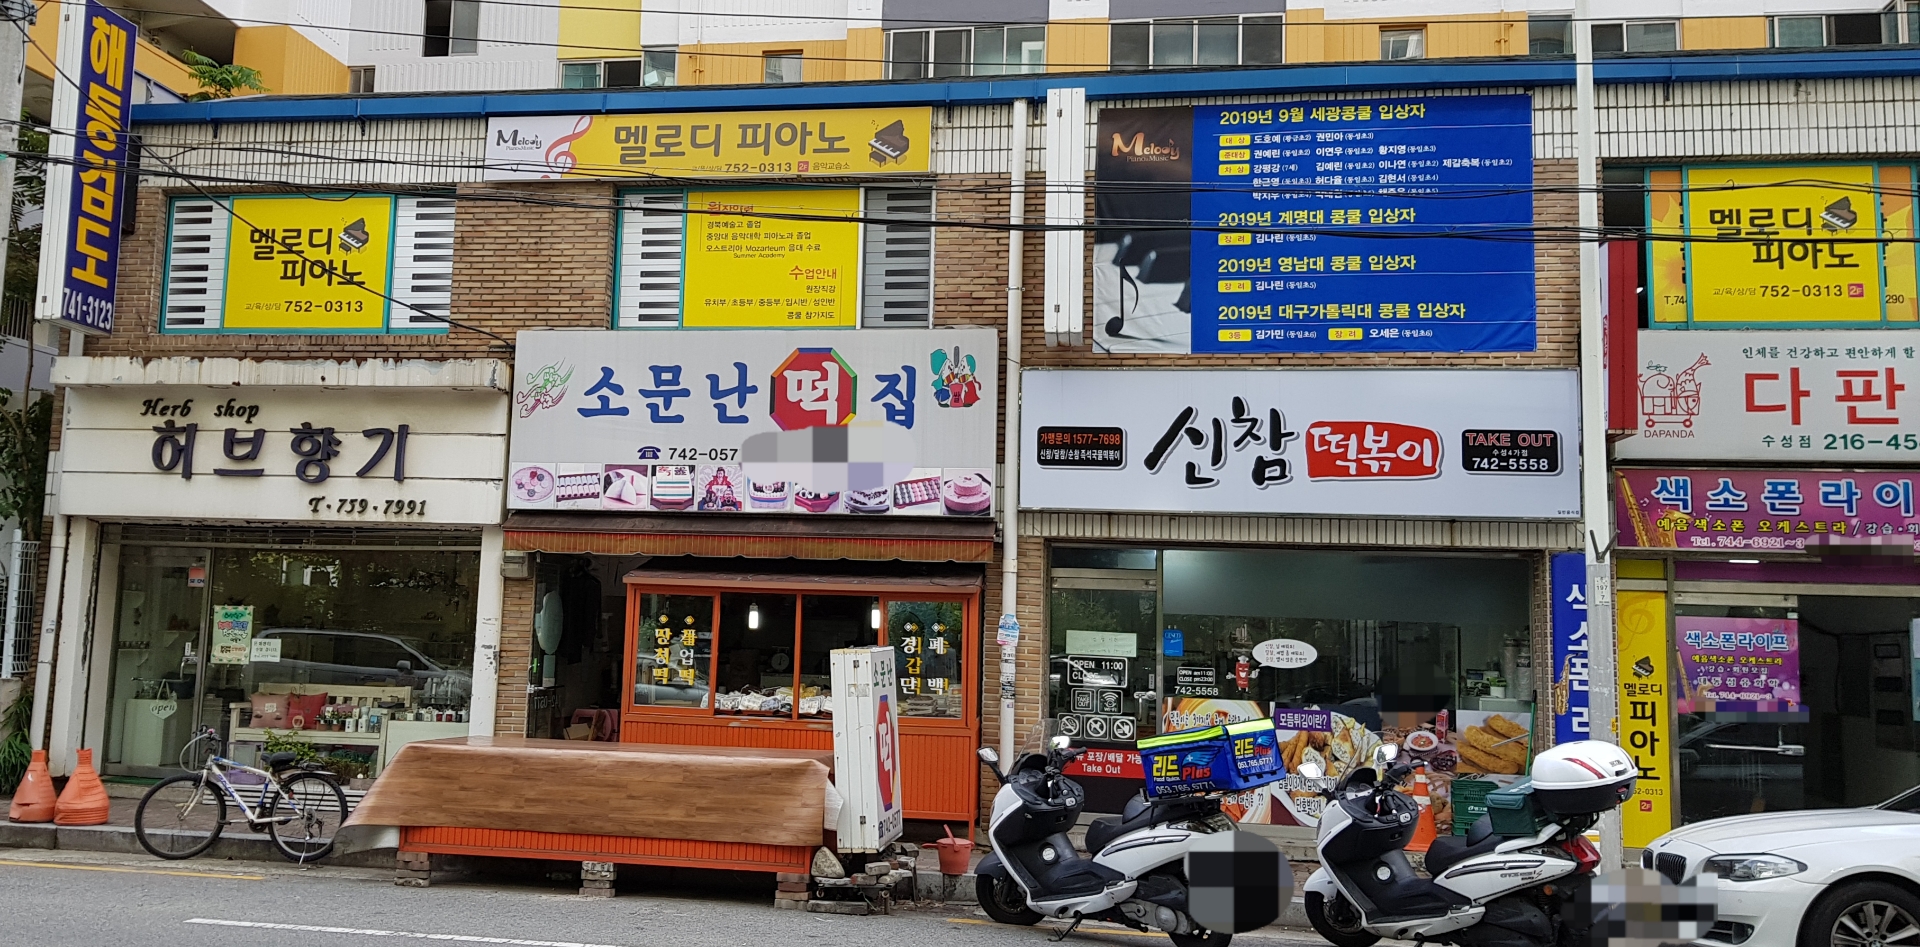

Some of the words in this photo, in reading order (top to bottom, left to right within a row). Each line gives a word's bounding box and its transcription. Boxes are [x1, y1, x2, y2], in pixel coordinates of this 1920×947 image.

[1220, 110, 1272, 125] 2019년
[1278, 107, 1304, 123] 9월
[1310, 105, 1372, 121] 세광콩쿨
[1379, 103, 1425, 119] 입상자
[614, 123, 722, 165] 멜로디
[737, 121, 850, 157] 피아노
[1315, 132, 1343, 141] 권민아
[71, 16, 127, 289] 해동검도
[1112, 132, 1180, 160] Melody
[1253, 149, 1280, 158] 권예린
[1316, 147, 1343, 156] 이연우
[1379, 145, 1406, 154] 황지영
[725, 162, 792, 173] 752-0313
[812, 162, 850, 171] 음악교습소
[1315, 162, 1343, 171] 김예린
[1379, 160, 1406, 170] 이나연
[1379, 173, 1406, 183] 김현서
[1218, 212, 1271, 226] 2019년
[1278, 211, 1323, 224] 계명대
[1330, 209, 1363, 224] 콩쿨
[1368, 208, 1416, 223] 입상자
[1709, 207, 1812, 240] 멜로디
[707, 220, 744, 229] 경북예술고
[706, 232, 728, 241] 중앙대
[731, 232, 761, 240] 음악대학
[764, 232, 793, 240] 피아노과
[1255, 233, 1284, 243] 김나린
[249, 227, 333, 261] 멜로디
[706, 244, 742, 252] 오스트리아
[746, 244, 785, 252] Mozarteum
[1752, 241, 1859, 270] 피아노
[1218, 258, 1271, 273] 2019년
[1278, 257, 1324, 272] 영남대
[1330, 256, 1362, 271] 콩쿨
[1368, 255, 1416, 270] 입상자
[280, 258, 366, 287] 피아노
[789, 265, 837, 280] 수업안내
[806, 285, 836, 293] 원장직강
[1255, 280, 1284, 291] 김나린
[1759, 284, 1843, 297] 752-0313
[62, 287, 113, 330] 741-3123
[284, 299, 364, 313] 752-0313
[1218, 305, 1271, 320] 2019년
[1278, 304, 1372, 319] 대구가톨릭대
[1378, 303, 1410, 319] 콩쿨
[1417, 302, 1465, 318] 입상자
[805, 311, 835, 319] 참가지도
[1255, 328, 1284, 339] 김가민
[1369, 327, 1399, 338] 오세은
[1742, 347, 1780, 358] 인체를
[1787, 347, 1839, 358] 건강하고
[1846, 347, 1896, 358] 편안하게
[1904, 347, 1915, 358] 할
[140, 397, 192, 418] Herb
[214, 398, 259, 424] shop
[1040, 433, 1070, 445] 가맹문의
[1073, 433, 1120, 445] 1577-7698
[1465, 433, 1510, 446] TAKE
[1518, 433, 1554, 447] OUT
[1644, 429, 1695, 438] DAPANDA
[1143, 396, 1293, 485] 신참
[1309, 424, 1434, 474] 떡볶이
[1762, 435, 1811, 448] 수성점
[151, 419, 409, 483] 허브향기
[1472, 458, 1548, 470] 742-5558
[1656, 518, 1745, 533] 예음색소폰
[1758, 519, 1848, 534] 오케스트라
[1684, 630, 1789, 651] 색소폰라이프
[1073, 660, 1095, 669] OPEN
[1101, 661, 1123, 670] 11:00
[1692, 655, 1735, 664] 예음색소폰
[1740, 656, 1783, 665] 오케스트라
[873, 658, 892, 687] 소문난
[1174, 686, 1218, 695] 742-5558
[1624, 683, 1662, 697] 멜로디
[151, 704, 175, 714] open
[1279, 713, 1327, 729] 모듬튀김이란?
[1234, 738, 1254, 755] 리드
[1630, 701, 1660, 780] 피아노
[878, 711, 894, 794] 떡
[1255, 745, 1271, 756] Plus
[1087, 752, 1124, 764] 포장/배달
[1237, 758, 1273, 769] 053.765.6771
[1082, 764, 1102, 773] Take
[1105, 764, 1120, 773] Out
[1153, 755, 1179, 776] 리드
[1182, 767, 1211, 780] Plus
[1155, 780, 1215, 794] 053.765.6771
